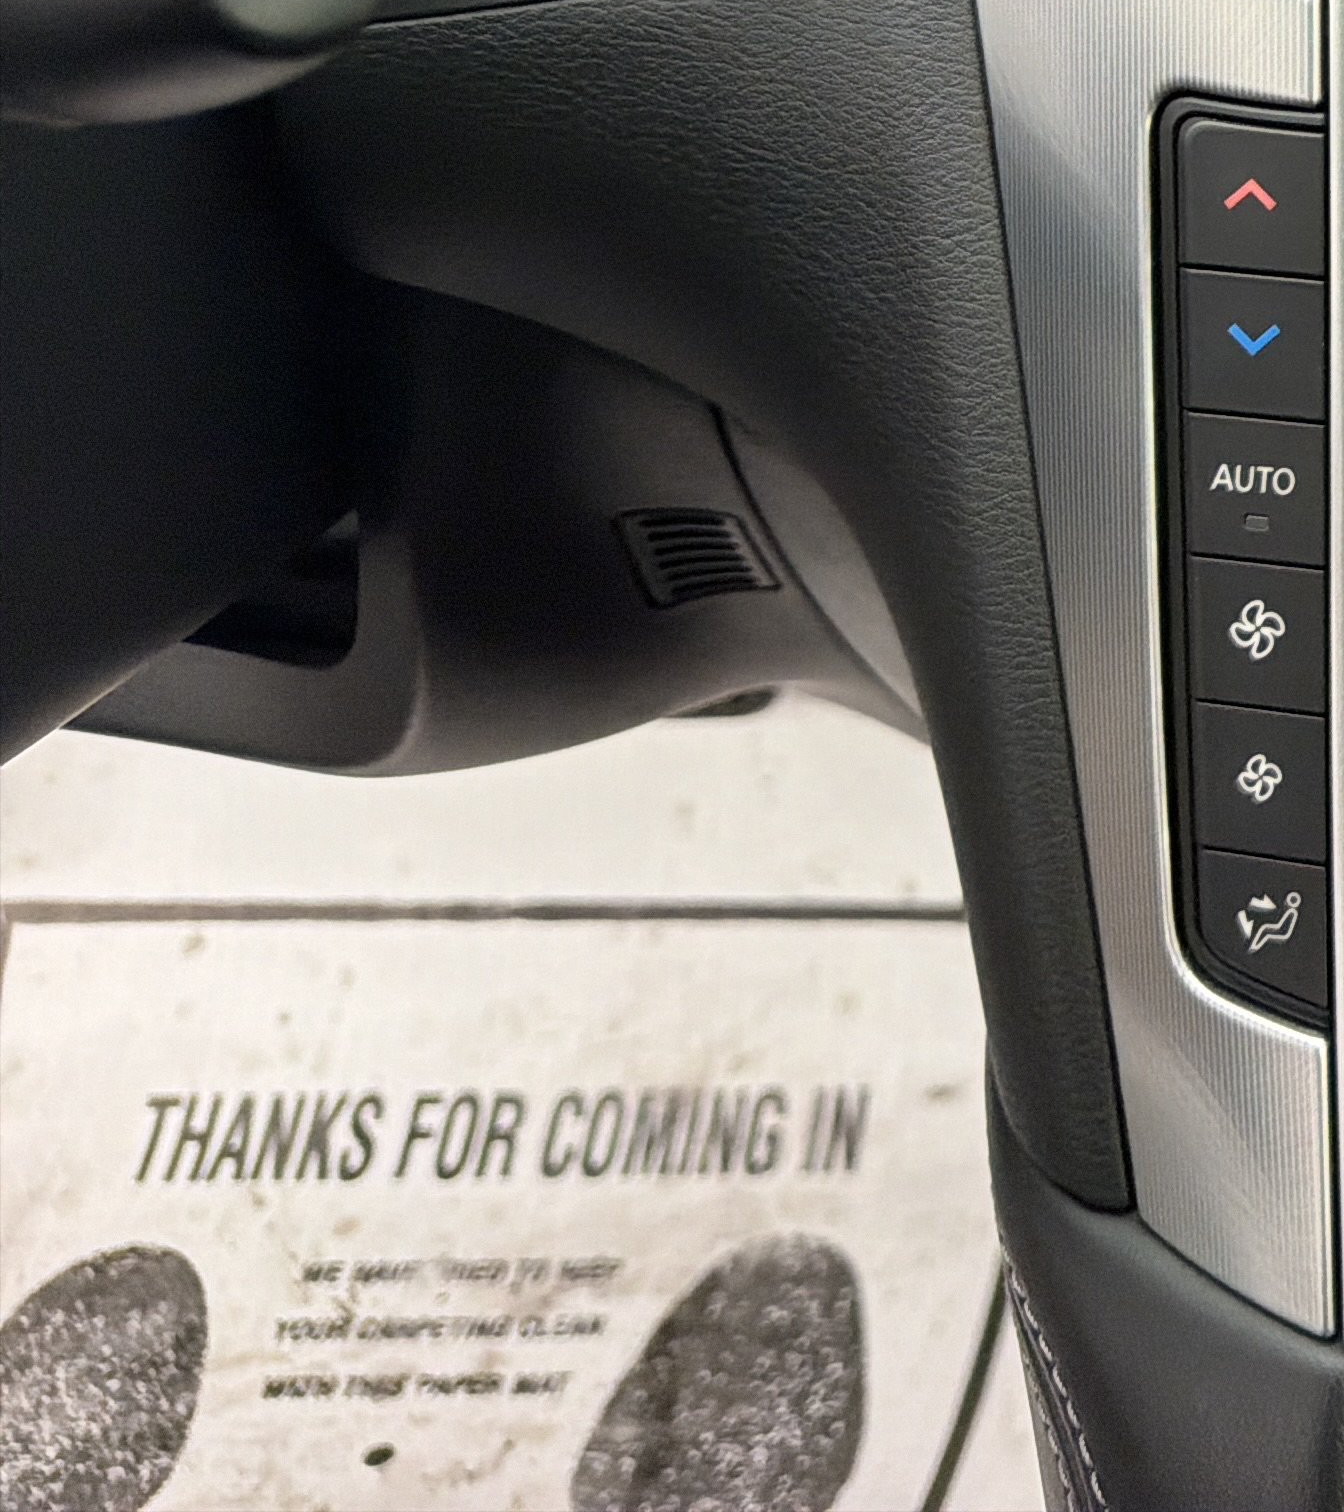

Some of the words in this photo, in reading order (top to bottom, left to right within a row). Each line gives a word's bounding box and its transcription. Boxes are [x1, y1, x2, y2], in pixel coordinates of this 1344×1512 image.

[1211, 463, 1295, 495] AUTO
[135, 1092, 383, 1181] THANKS
[393, 1091, 530, 1180] FOR
[543, 1090, 785, 1178] COMING
[803, 1089, 870, 1173] IN
